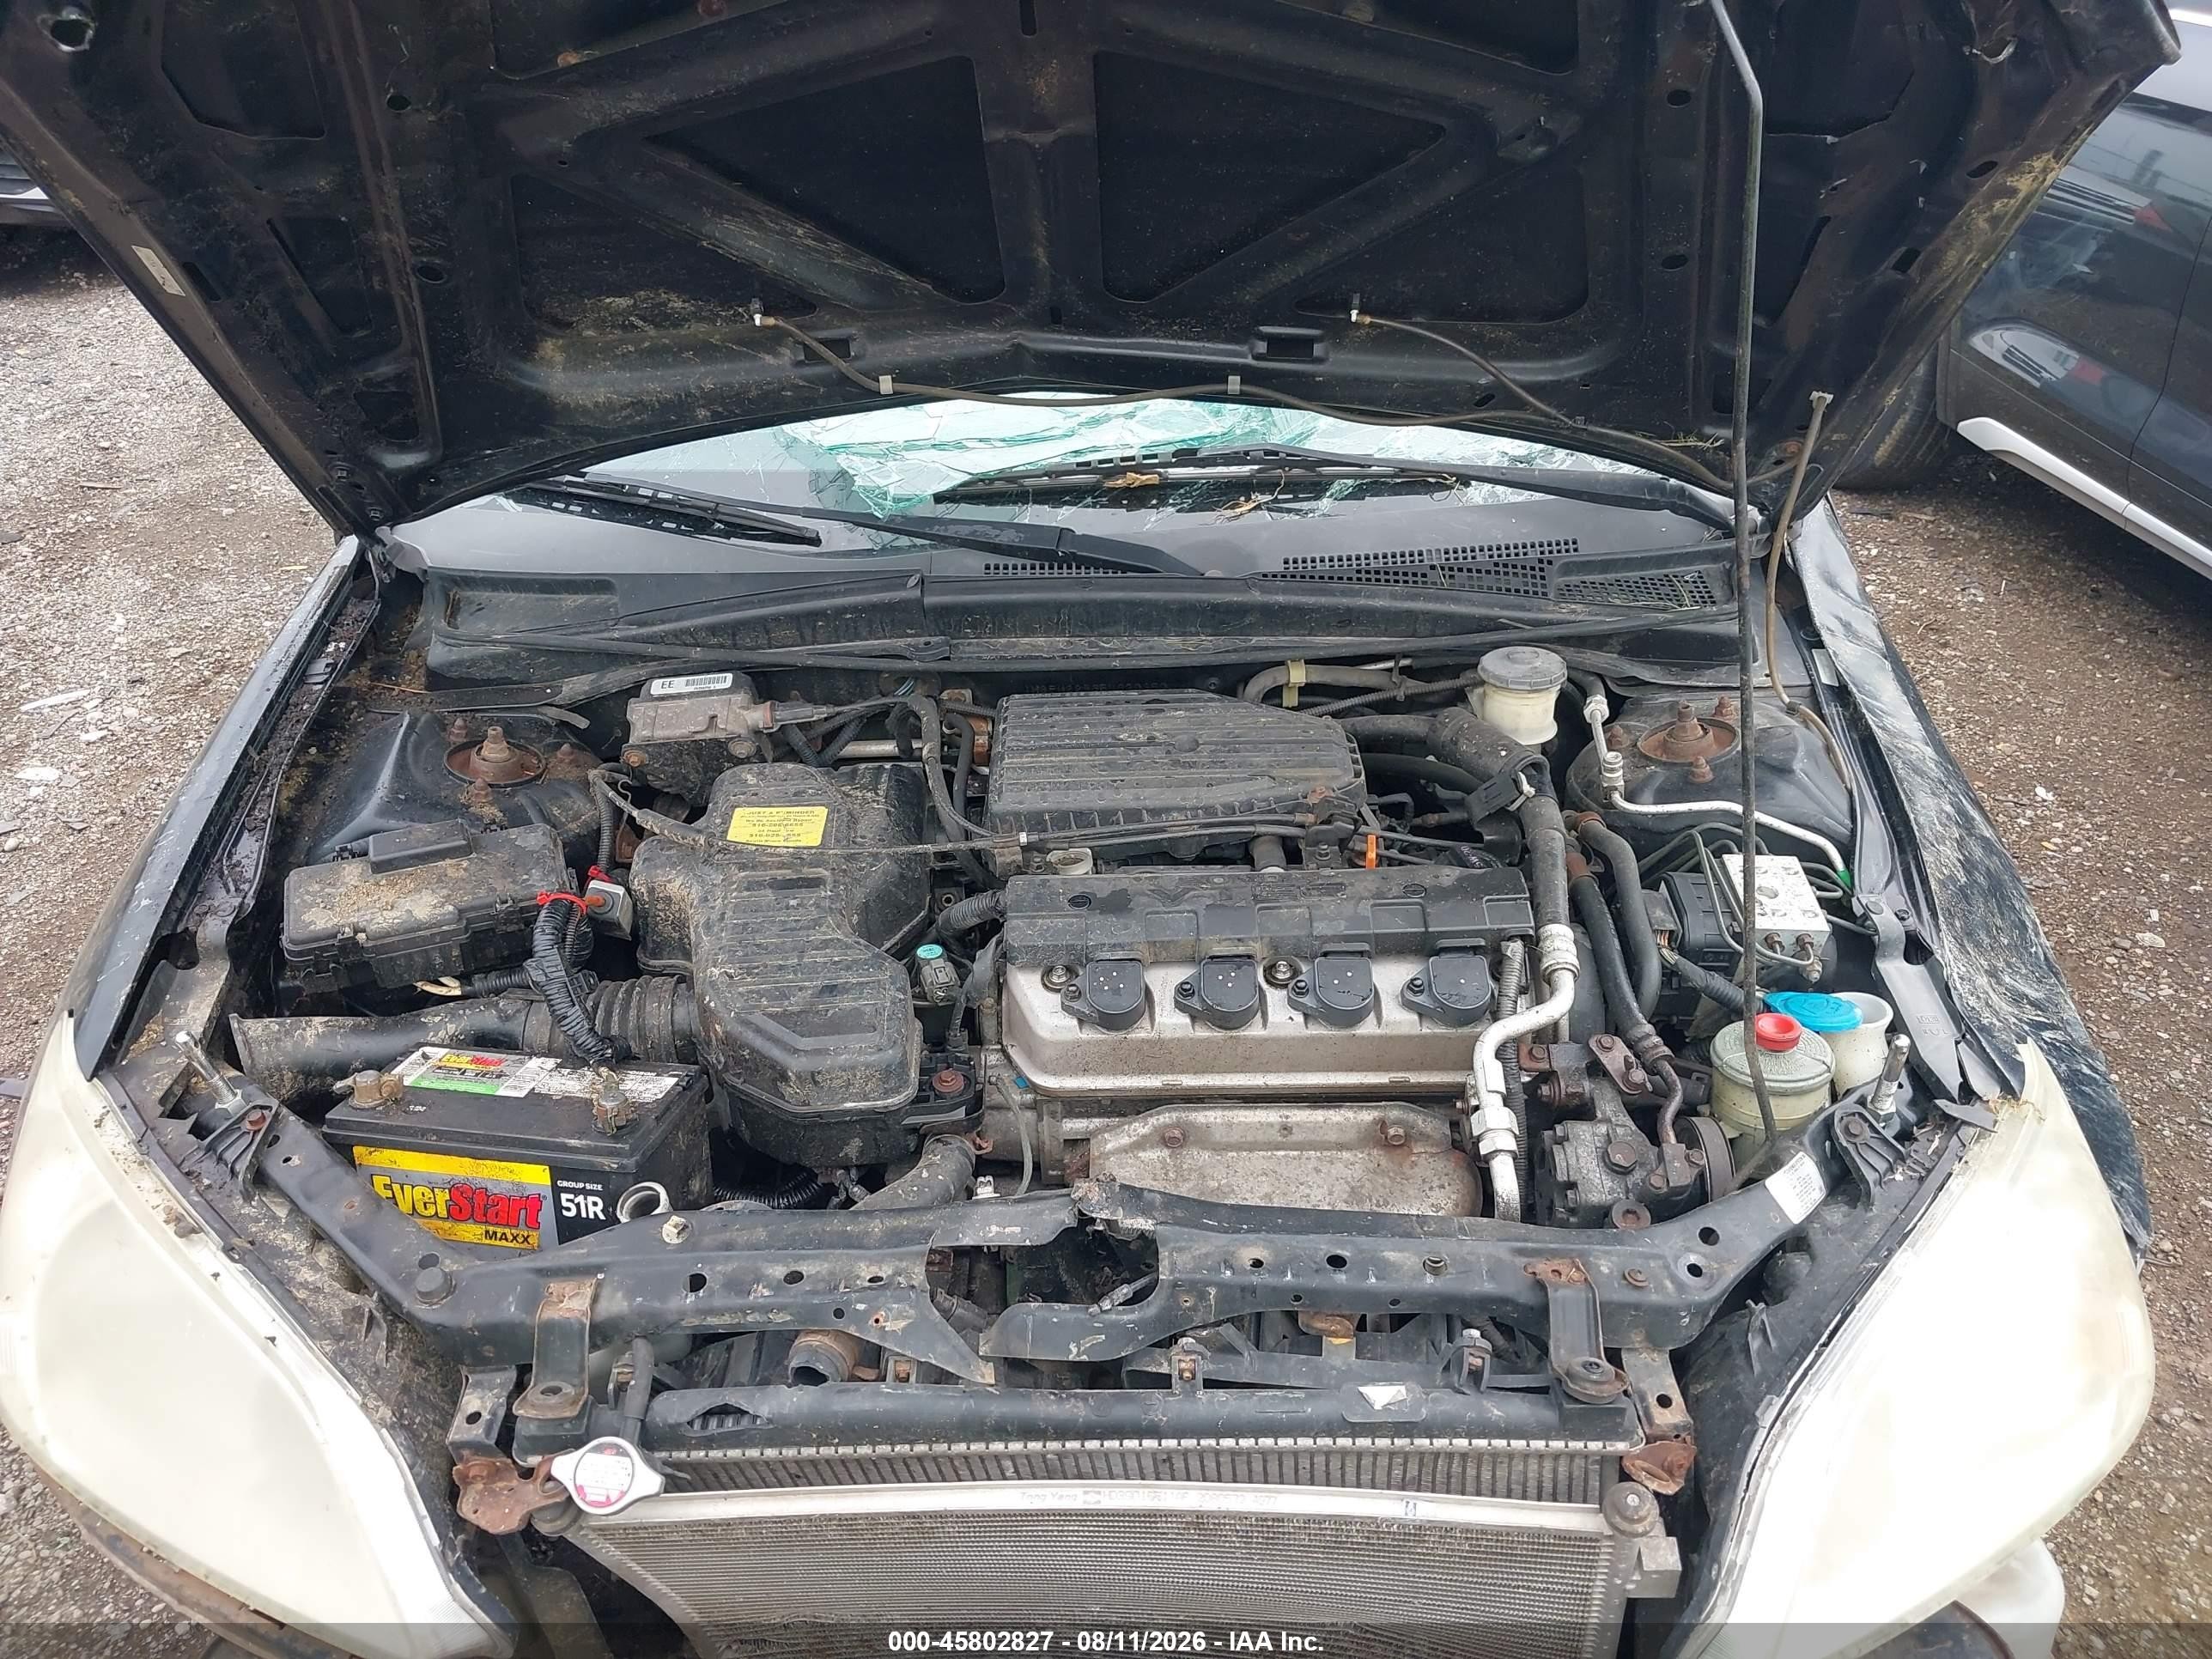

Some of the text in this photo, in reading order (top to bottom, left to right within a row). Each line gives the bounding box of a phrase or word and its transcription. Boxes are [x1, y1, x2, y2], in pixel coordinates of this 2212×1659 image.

[660, 680, 675, 689] EE
[556, 1180, 604, 1191] GROUP SIZE
[371, 1174, 543, 1230] EverStart
[560, 1193, 606, 1220] 51R
[484, 1230, 531, 1245] MAXX
